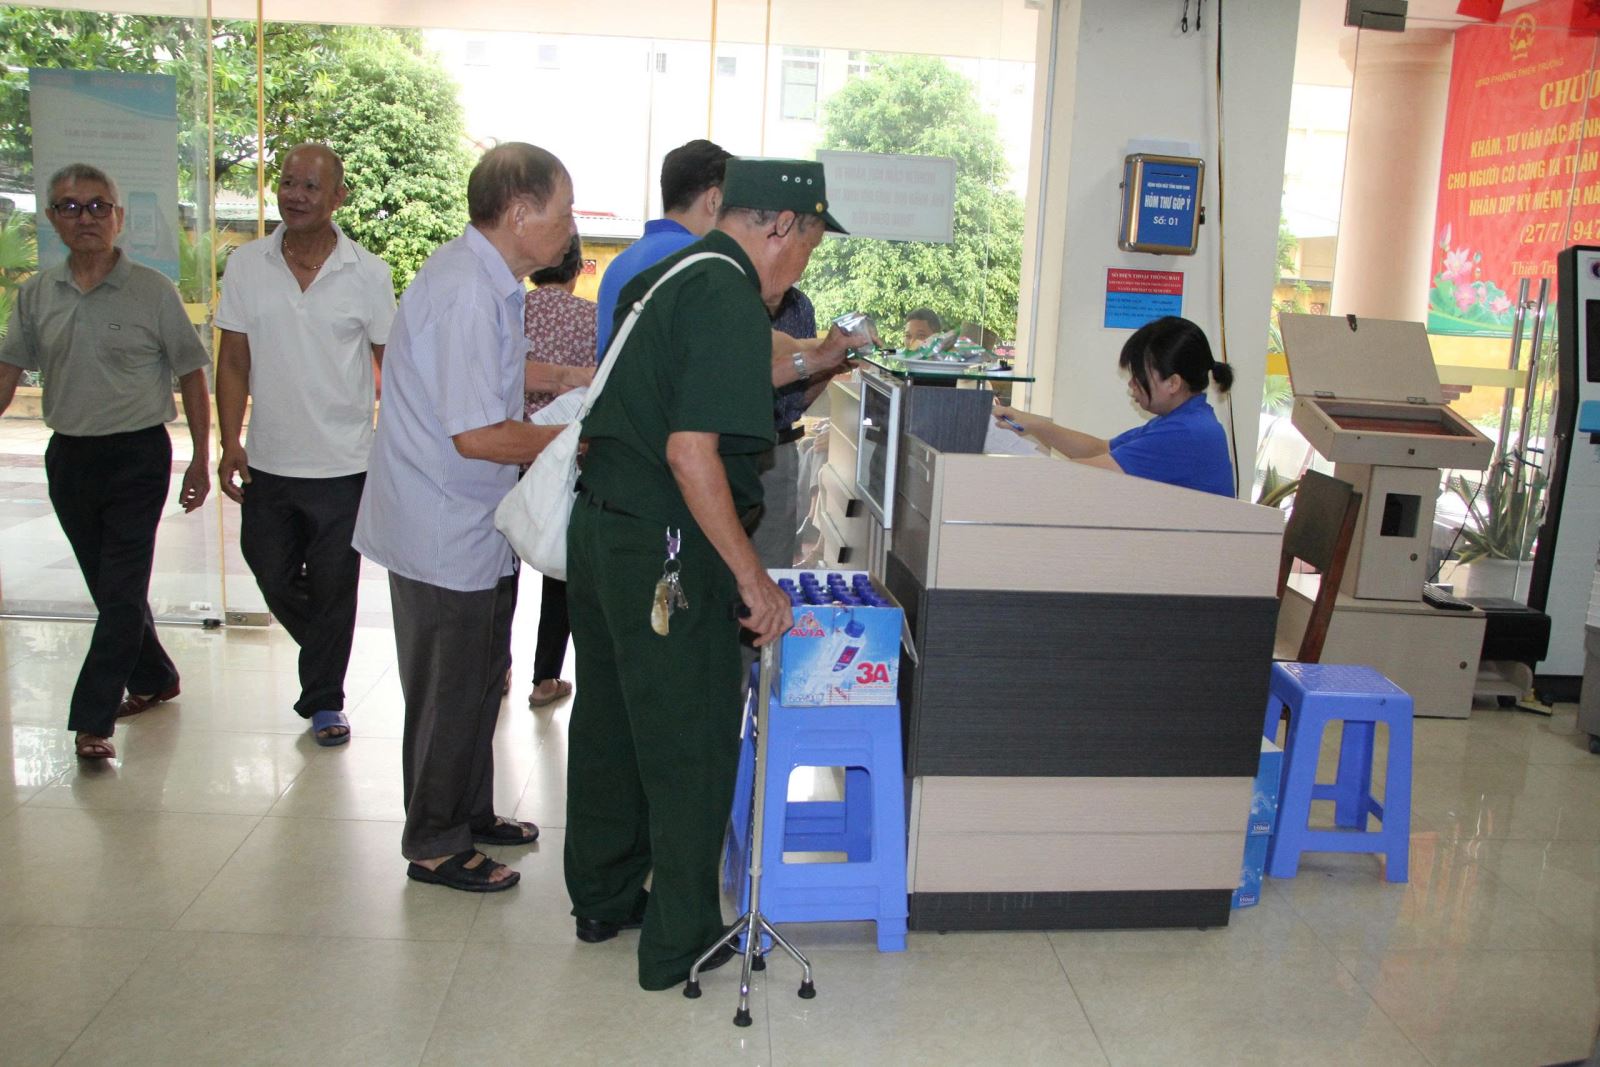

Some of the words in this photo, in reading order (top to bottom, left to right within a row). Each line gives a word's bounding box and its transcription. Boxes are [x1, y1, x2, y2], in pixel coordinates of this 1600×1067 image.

[1447, 172, 1468, 191] CHO
[1153, 216, 1166, 225] Số:
[1168, 217, 1178, 226] 01
[789, 628, 826, 638] AVIA
[856, 661, 890, 685] 3A
